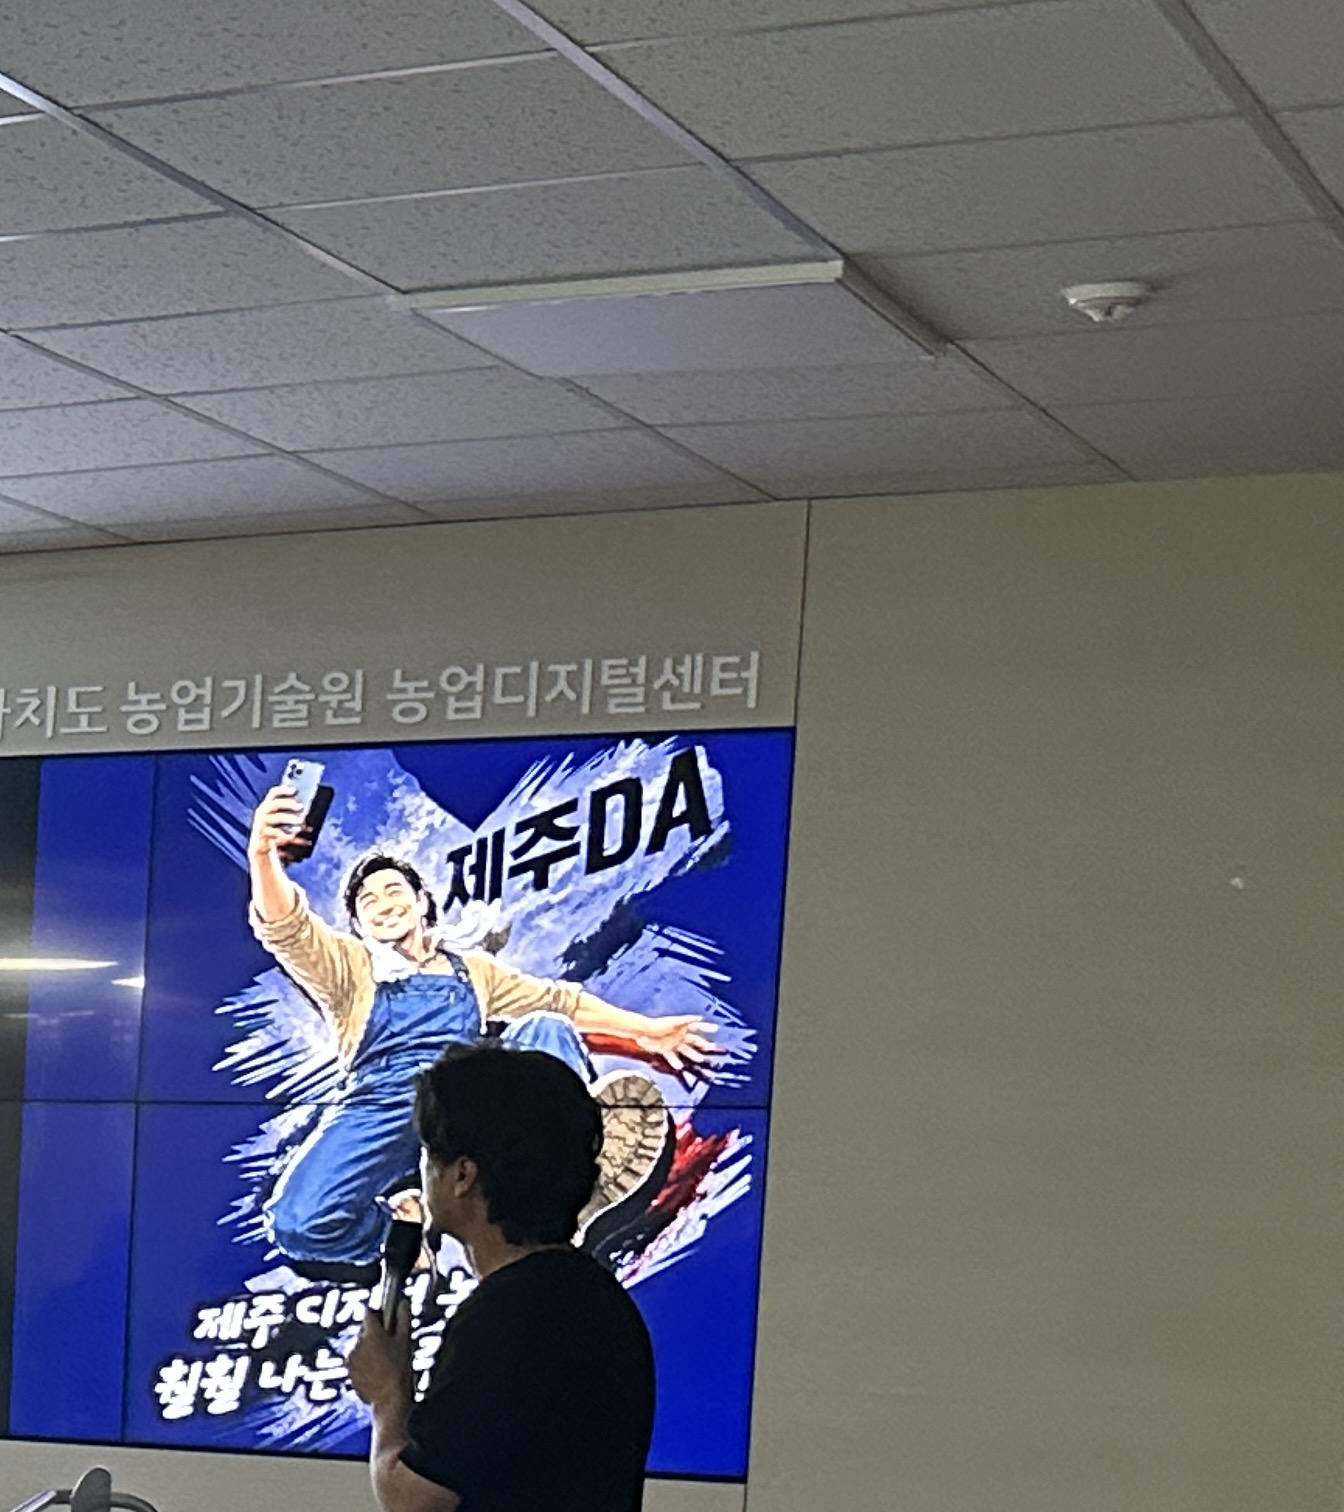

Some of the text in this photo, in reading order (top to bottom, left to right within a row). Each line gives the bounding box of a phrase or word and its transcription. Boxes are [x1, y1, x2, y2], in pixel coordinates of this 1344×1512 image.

[120, 669, 365, 735] 농업기술원
[387, 650, 760, 726] 농업디지털센터
[442, 746, 713, 914] 제주DA
[193, 1294, 286, 1349] 제주
[258, 1349, 349, 1401] 나는
